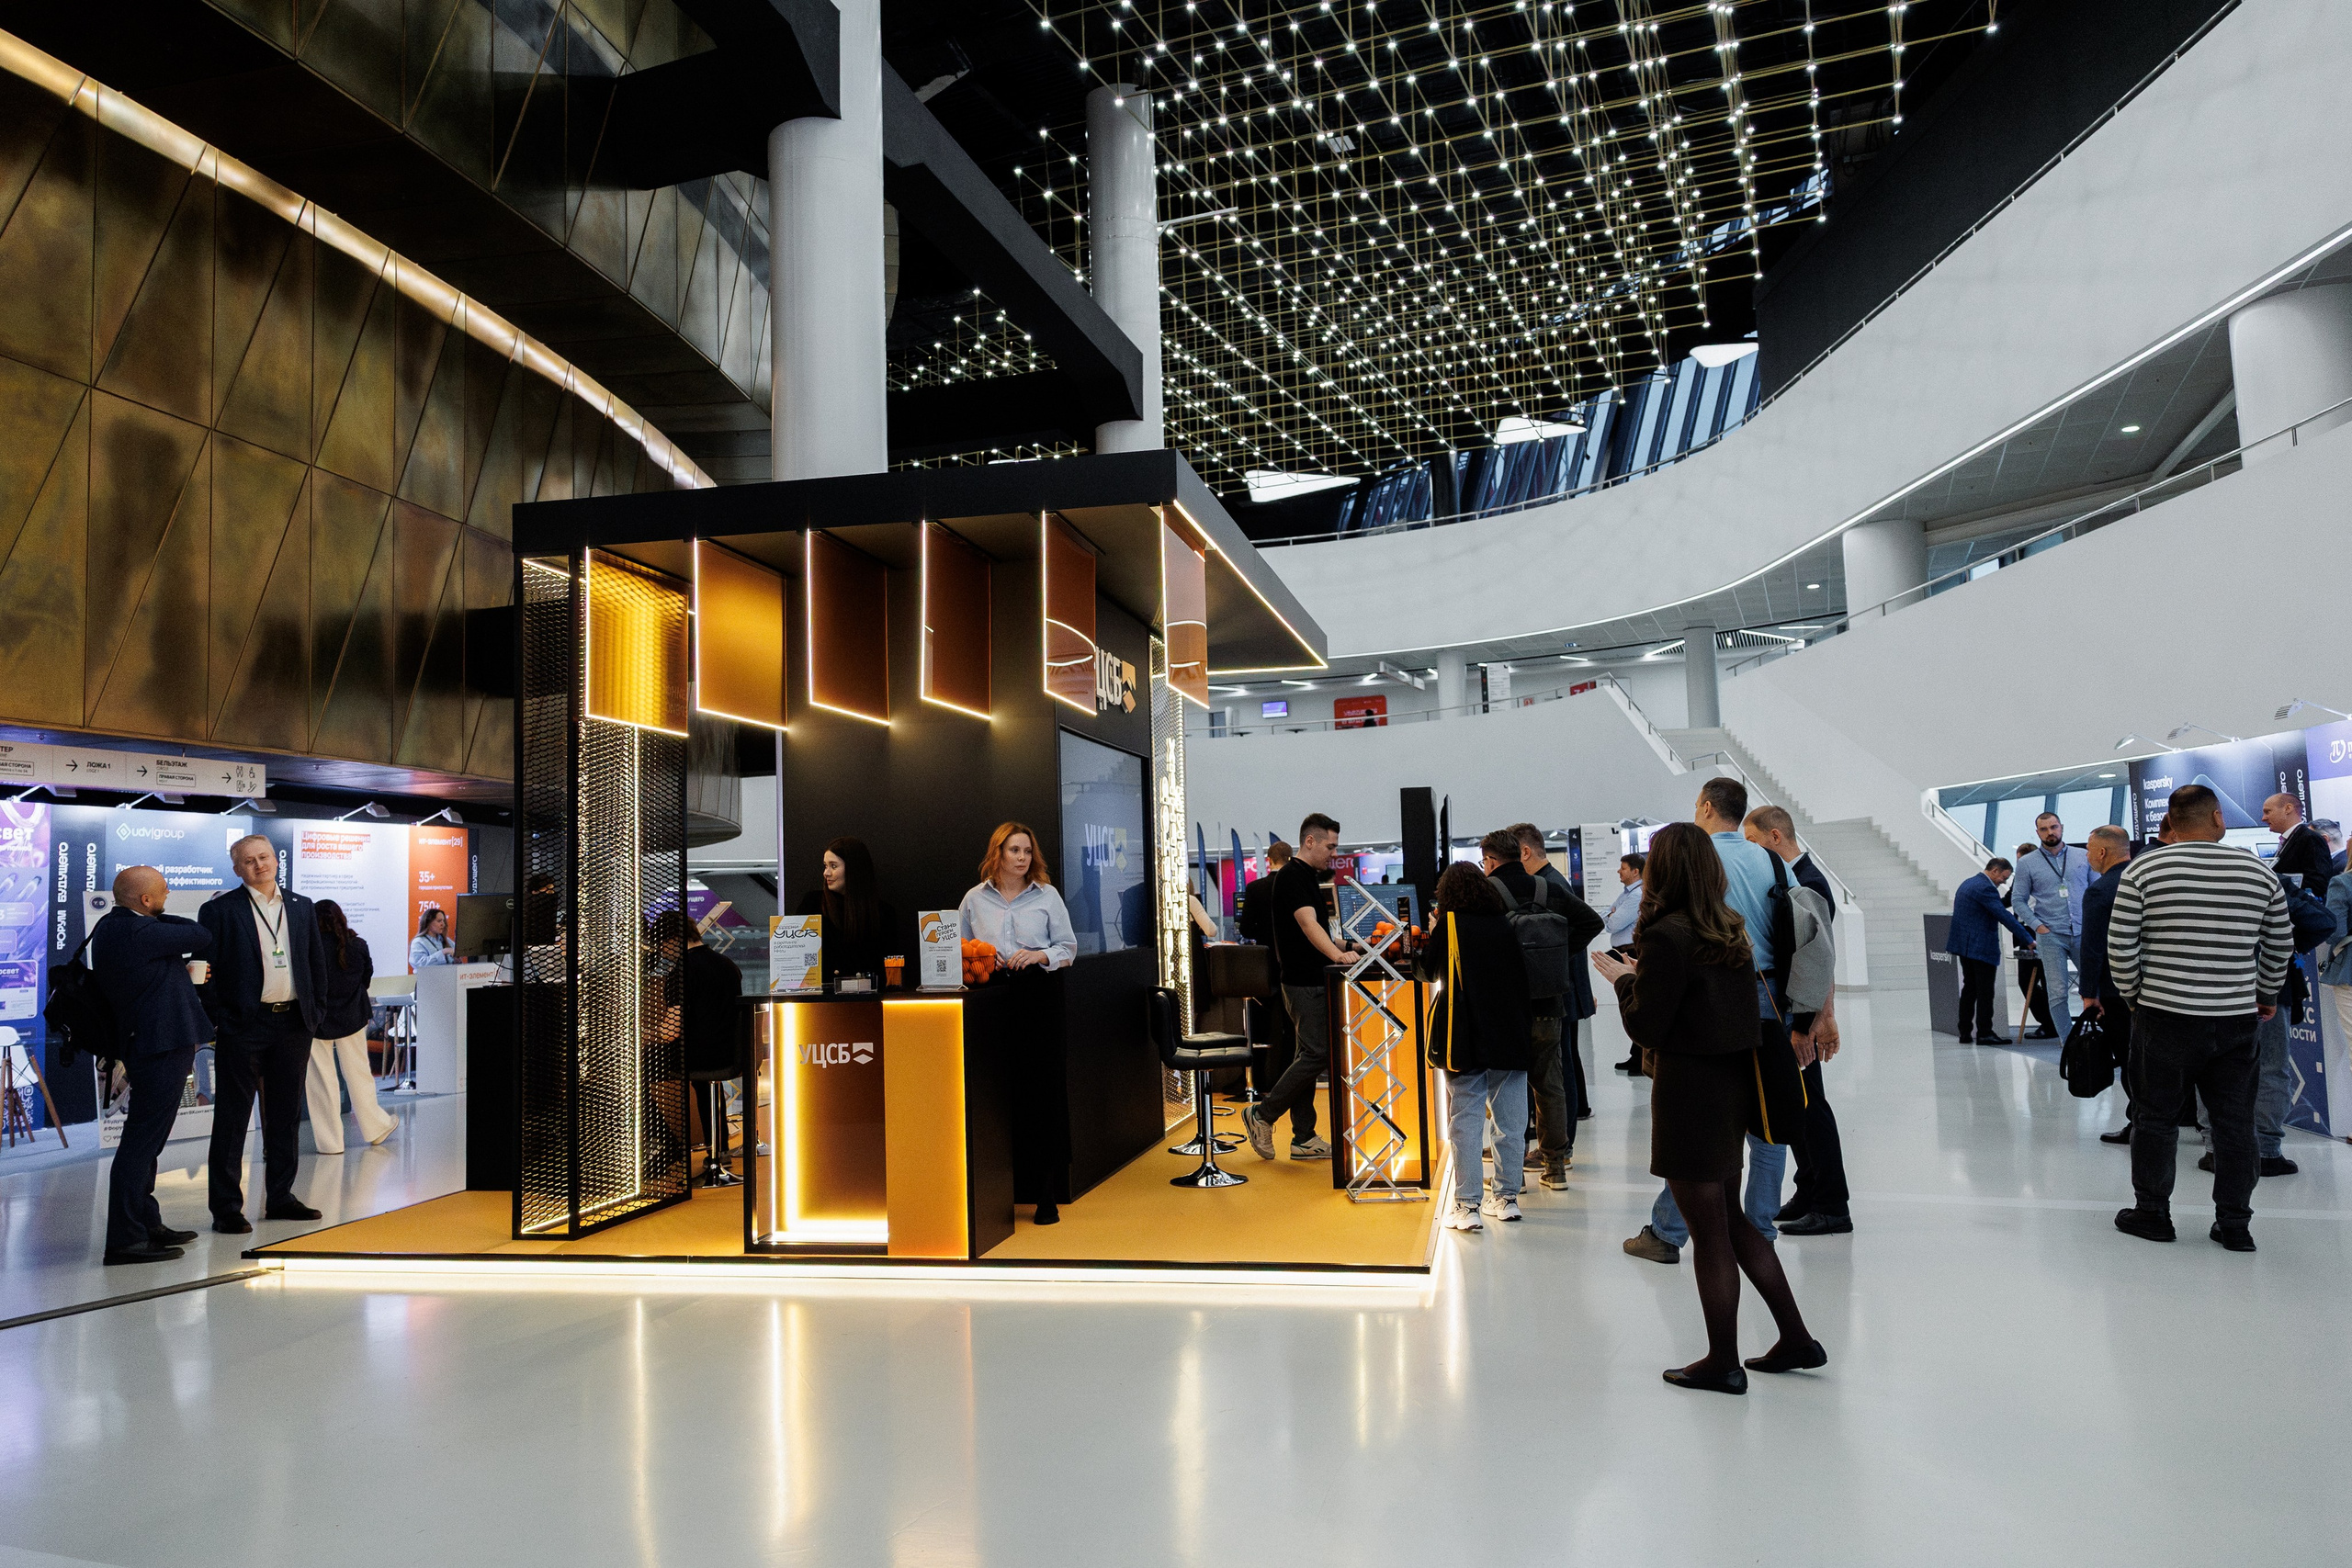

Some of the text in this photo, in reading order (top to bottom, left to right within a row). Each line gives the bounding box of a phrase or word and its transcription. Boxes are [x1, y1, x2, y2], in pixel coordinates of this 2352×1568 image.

[1096, 646, 1122, 710] ЦСБ
[156, 760, 187, 768] БЕЛЬЭТАЖ
[2143, 775, 2173, 791] kaspersky
[2144, 797, 2169, 809] Комплек
[301, 831, 370, 844] Цифровые решения
[316, 842, 337, 852] роста
[337, 843, 363, 852] вашего
[1085, 823, 1115, 875] УЦСБ
[301, 852, 352, 860] производства
[85, 842, 96, 893] ДУЩЕГО
[165, 863, 213, 875] разработчик
[169, 876, 223, 886] эффективного
[418, 871, 435, 883] 35+
[418, 900, 441, 913] 750+
[57, 909, 67, 951] ФОРУМ
[936, 922, 956, 932] Стань
[2290, 1025, 2317, 1043] ОСТИ
[798, 1043, 851, 1069] УЦСБ
